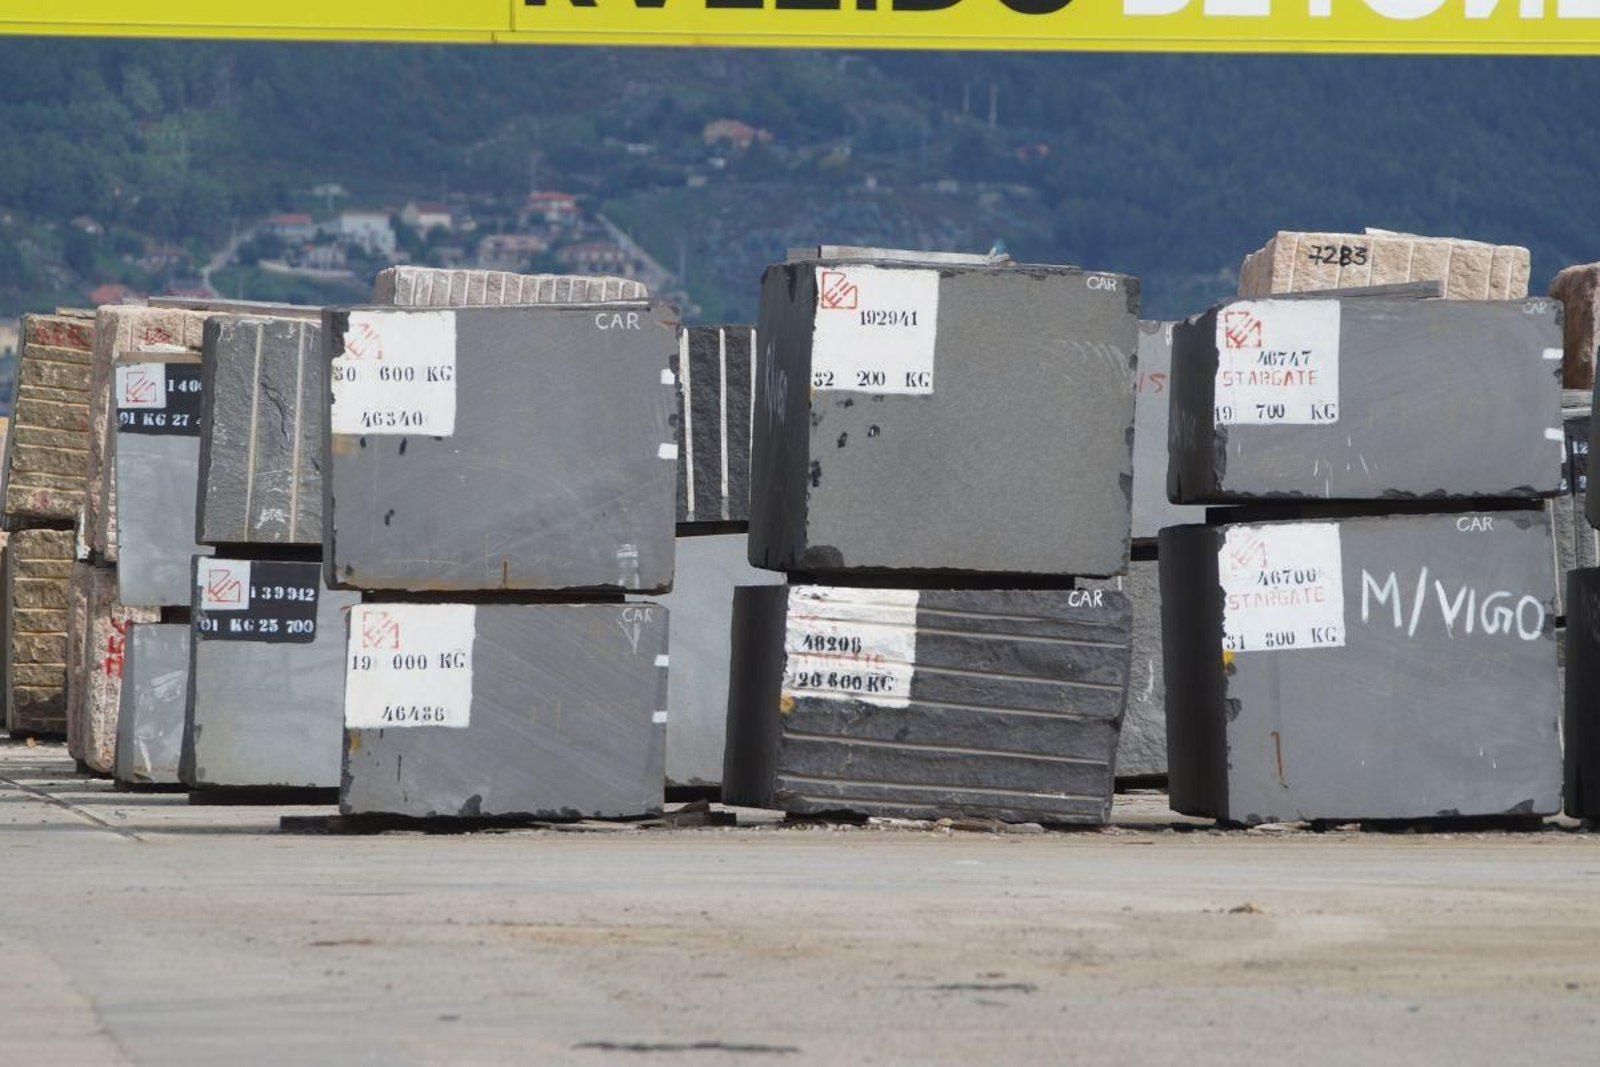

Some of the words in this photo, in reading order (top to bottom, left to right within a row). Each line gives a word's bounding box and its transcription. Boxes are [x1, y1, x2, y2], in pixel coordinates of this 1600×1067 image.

[1308, 244, 1367, 267] 7283
[1086, 276, 1117, 292] CAR
[595, 312, 641, 330] CAR
[860, 310, 918, 327] 192941
[1257, 350, 1312, 366] 46747
[379, 366, 415, 382] 600
[426, 366, 453, 382] KG
[813, 371, 834, 387] 32
[857, 370, 886, 386] 200
[905, 371, 931, 388] KG
[1223, 370, 1318, 387] STARGATE
[143, 412, 167, 427] KG
[172, 414, 190, 427] 27
[361, 411, 424, 427] 46340
[1256, 404, 1285, 419] 700
[1311, 403, 1336, 420] KG
[1456, 516, 1494, 532] CAR
[1258, 568, 1318, 587] 46700
[1068, 589, 1104, 608] CAR
[1228, 586, 1325, 611] STARGATE
[621, 607, 653, 623] CAR
[230, 618, 255, 633] KG
[258, 618, 279, 633] 25
[285, 619, 314, 634] 700
[1265, 630, 1296, 648] 800
[1311, 626, 1338, 644] KG
[352, 654, 372, 671] 19
[392, 653, 428, 671] 000
[439, 652, 466, 669] KG
[866, 675, 895, 693] KG
[381, 705, 446, 723] 46486
